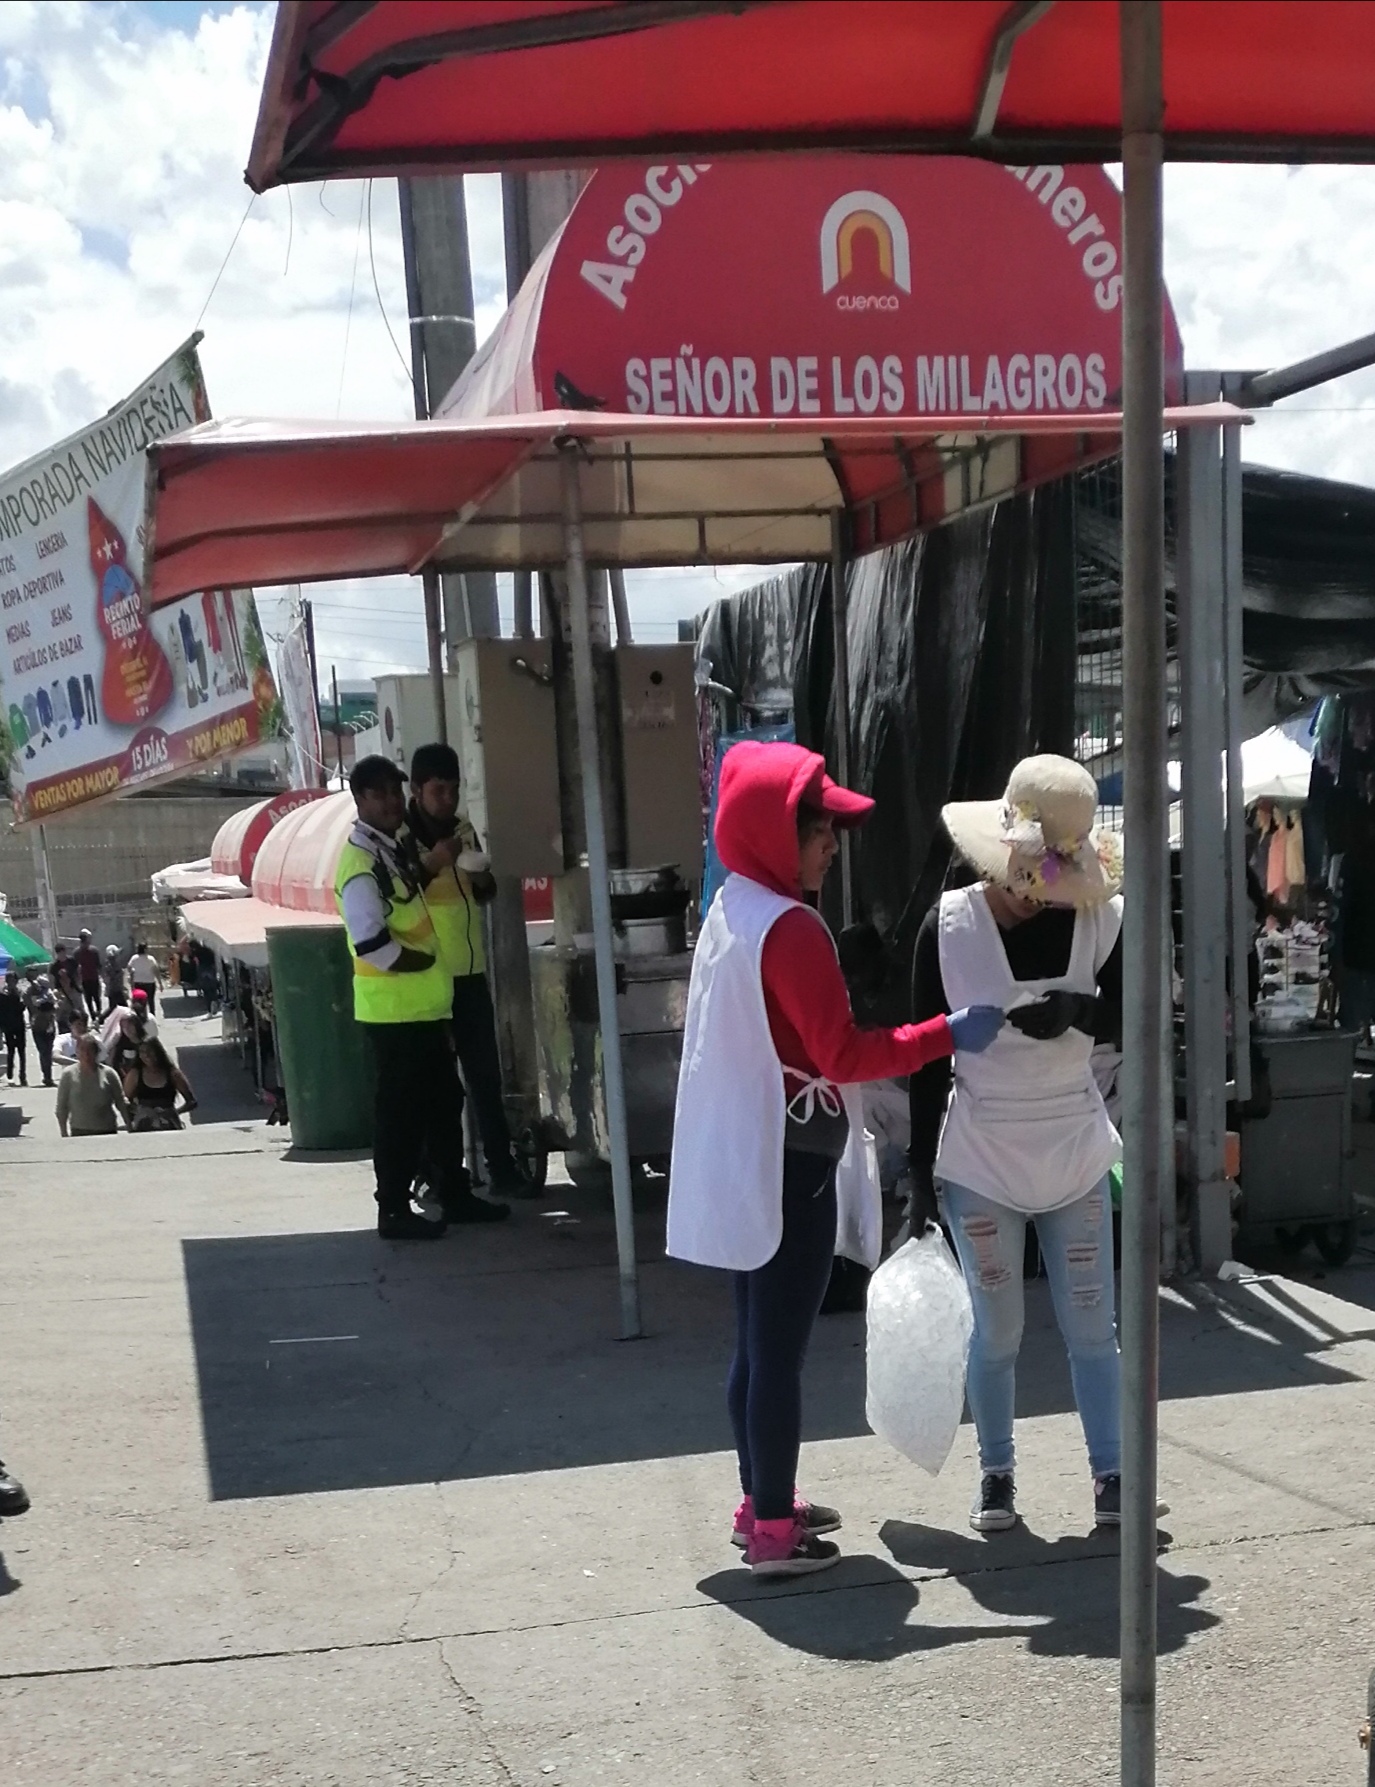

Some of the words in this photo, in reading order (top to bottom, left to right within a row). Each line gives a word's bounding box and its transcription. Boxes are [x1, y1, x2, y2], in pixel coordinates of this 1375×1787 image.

[1004, 165, 1123, 310] neros
[837, 295, 899, 309] cuenca
[625, 343, 760, 414] SEÑOR
[770, 356, 821, 413] DE
[832, 355, 905, 413] LOS
[917, 353, 1107, 411] MILAGROS
[81, 381, 192, 482] NAVIDEÑA
[2, 587, 23, 610] ROPA
[22, 569, 65, 602] DEPORTIVA
[50, 603, 73, 627] JEANS
[103, 592, 140, 625] RECINTO
[110, 612, 142, 640] FERIAL
[5, 620, 31, 644] MEDIAS
[48, 644, 59, 662] DE
[59, 634, 84, 658] BAZAR
[131, 745, 143, 771] 15
[142, 734, 168, 767] DÍAS
[185, 739, 194, 758] Y
[212, 717, 248, 749] MENOR
[31, 783, 67, 809] VENTAS
[65, 777, 86, 800] POR
[85, 766, 119, 793] MAYOR
